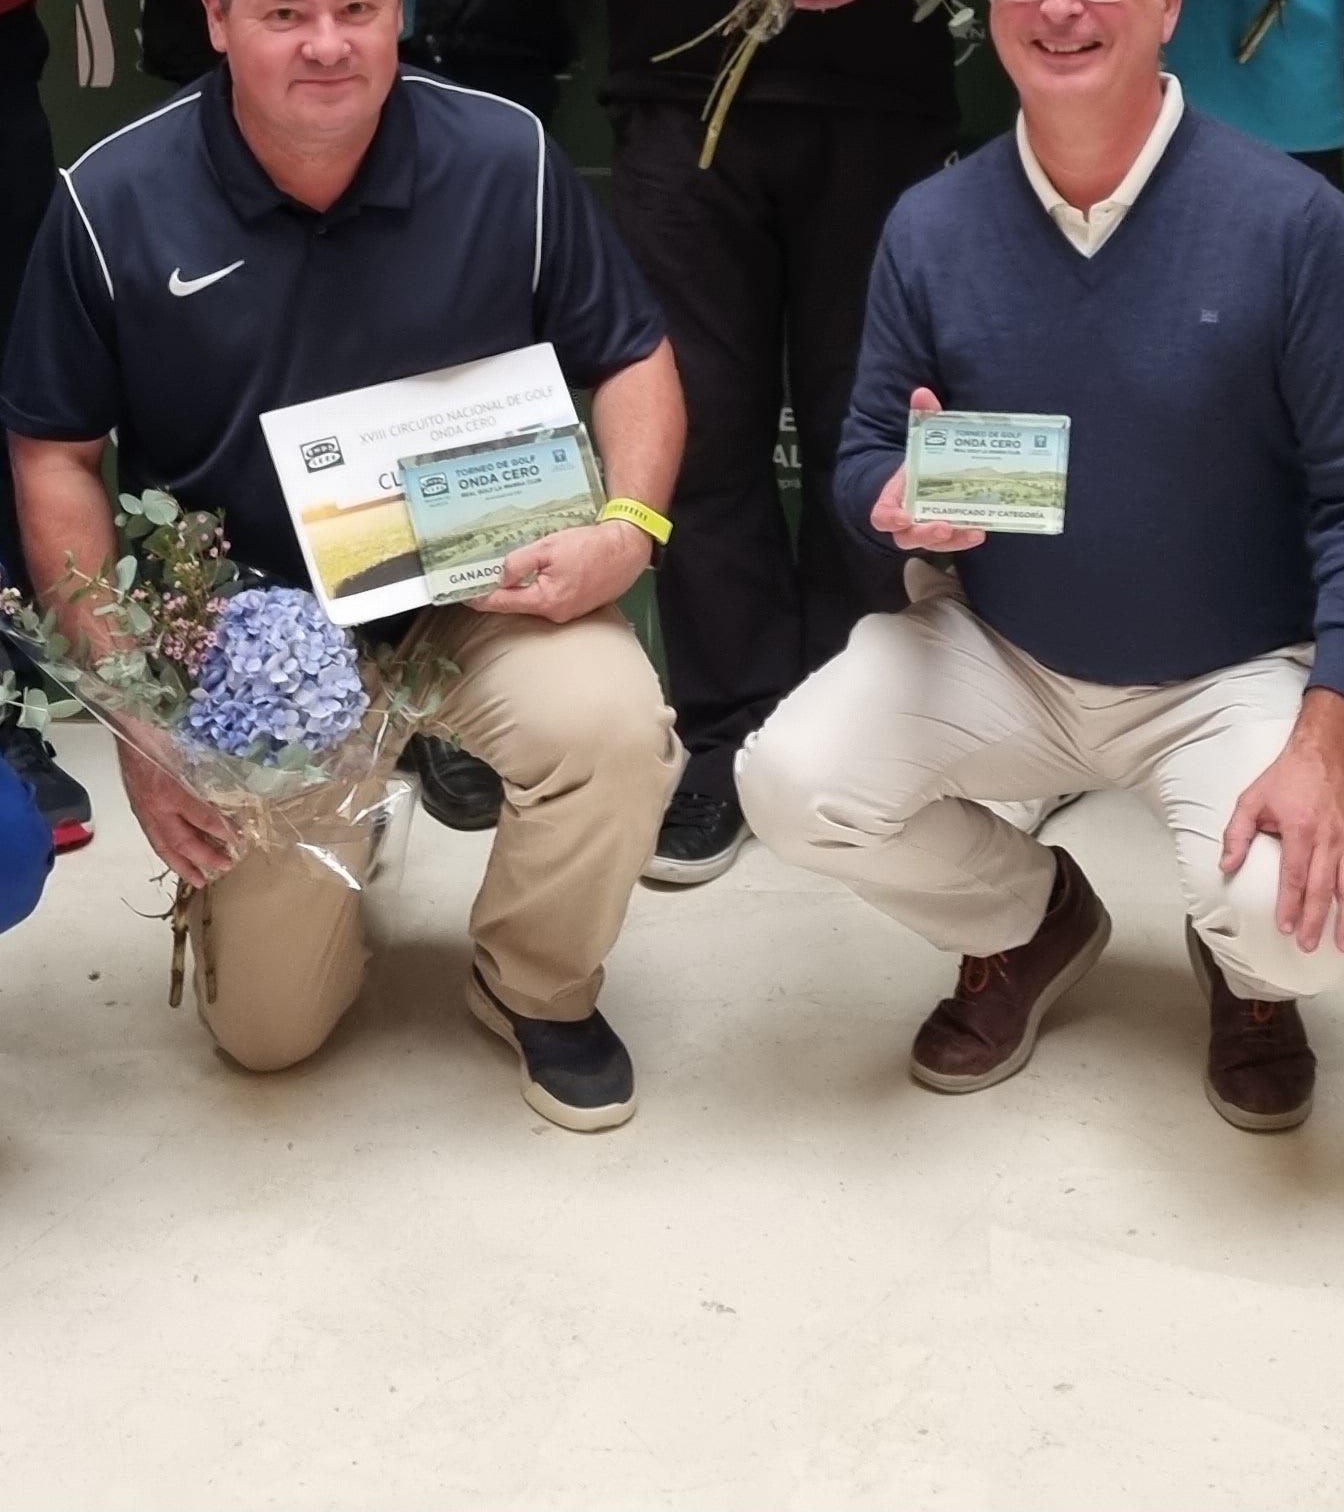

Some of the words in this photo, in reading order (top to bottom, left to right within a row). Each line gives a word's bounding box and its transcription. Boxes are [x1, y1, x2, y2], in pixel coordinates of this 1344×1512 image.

[359, 429, 388, 446] XVIII
[387, 412, 446, 441] CIRCUITO
[445, 398, 507, 427] NACIONAL
[506, 392, 524, 409] DE
[524, 385, 555, 405] GOLF
[429, 422, 463, 443] ONDA
[463, 414, 498, 435] CERO
[954, 437, 988, 448] ONDA
[990, 439, 1022, 449] CERO
[455, 464, 494, 478] TORNEO
[495, 459, 510, 470] DE
[510, 455, 536, 468] GOLF
[457, 474, 499, 491] ONDA
[502, 464, 541, 483] CERO
[449, 563, 505, 585] GANADO
